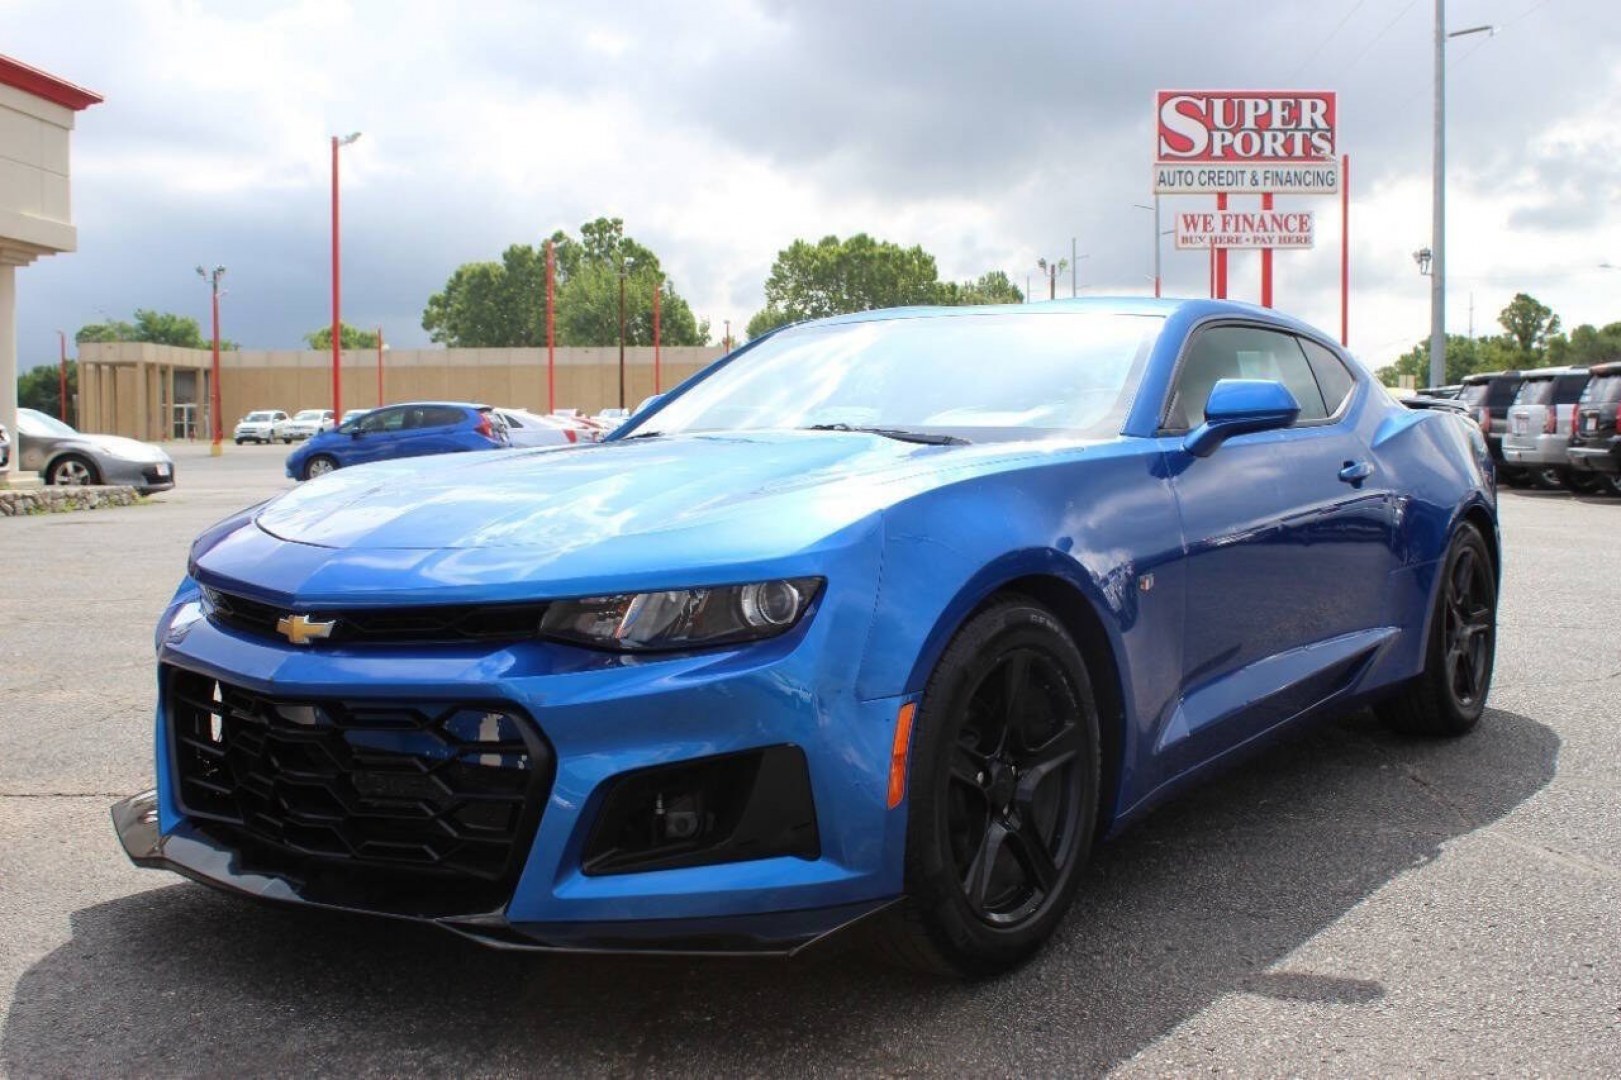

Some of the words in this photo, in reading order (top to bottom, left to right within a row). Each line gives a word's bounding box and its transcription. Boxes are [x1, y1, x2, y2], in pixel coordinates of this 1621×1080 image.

[1160, 95, 1330, 157] SUPER
[1158, 170, 1194, 187] AUTO
[1198, 170, 1246, 187] CREDIT
[1250, 170, 1259, 187] &
[1263, 170, 1336, 187] FINANCING
[1182, 213, 1214, 232] WE
[1221, 213, 1311, 233] FINANCE
[1181, 235, 1206, 245] BUY
[1209, 235, 1242, 245] HERE
[1253, 235, 1277, 245] PAY
[1278, 235, 1312, 245] HERE
